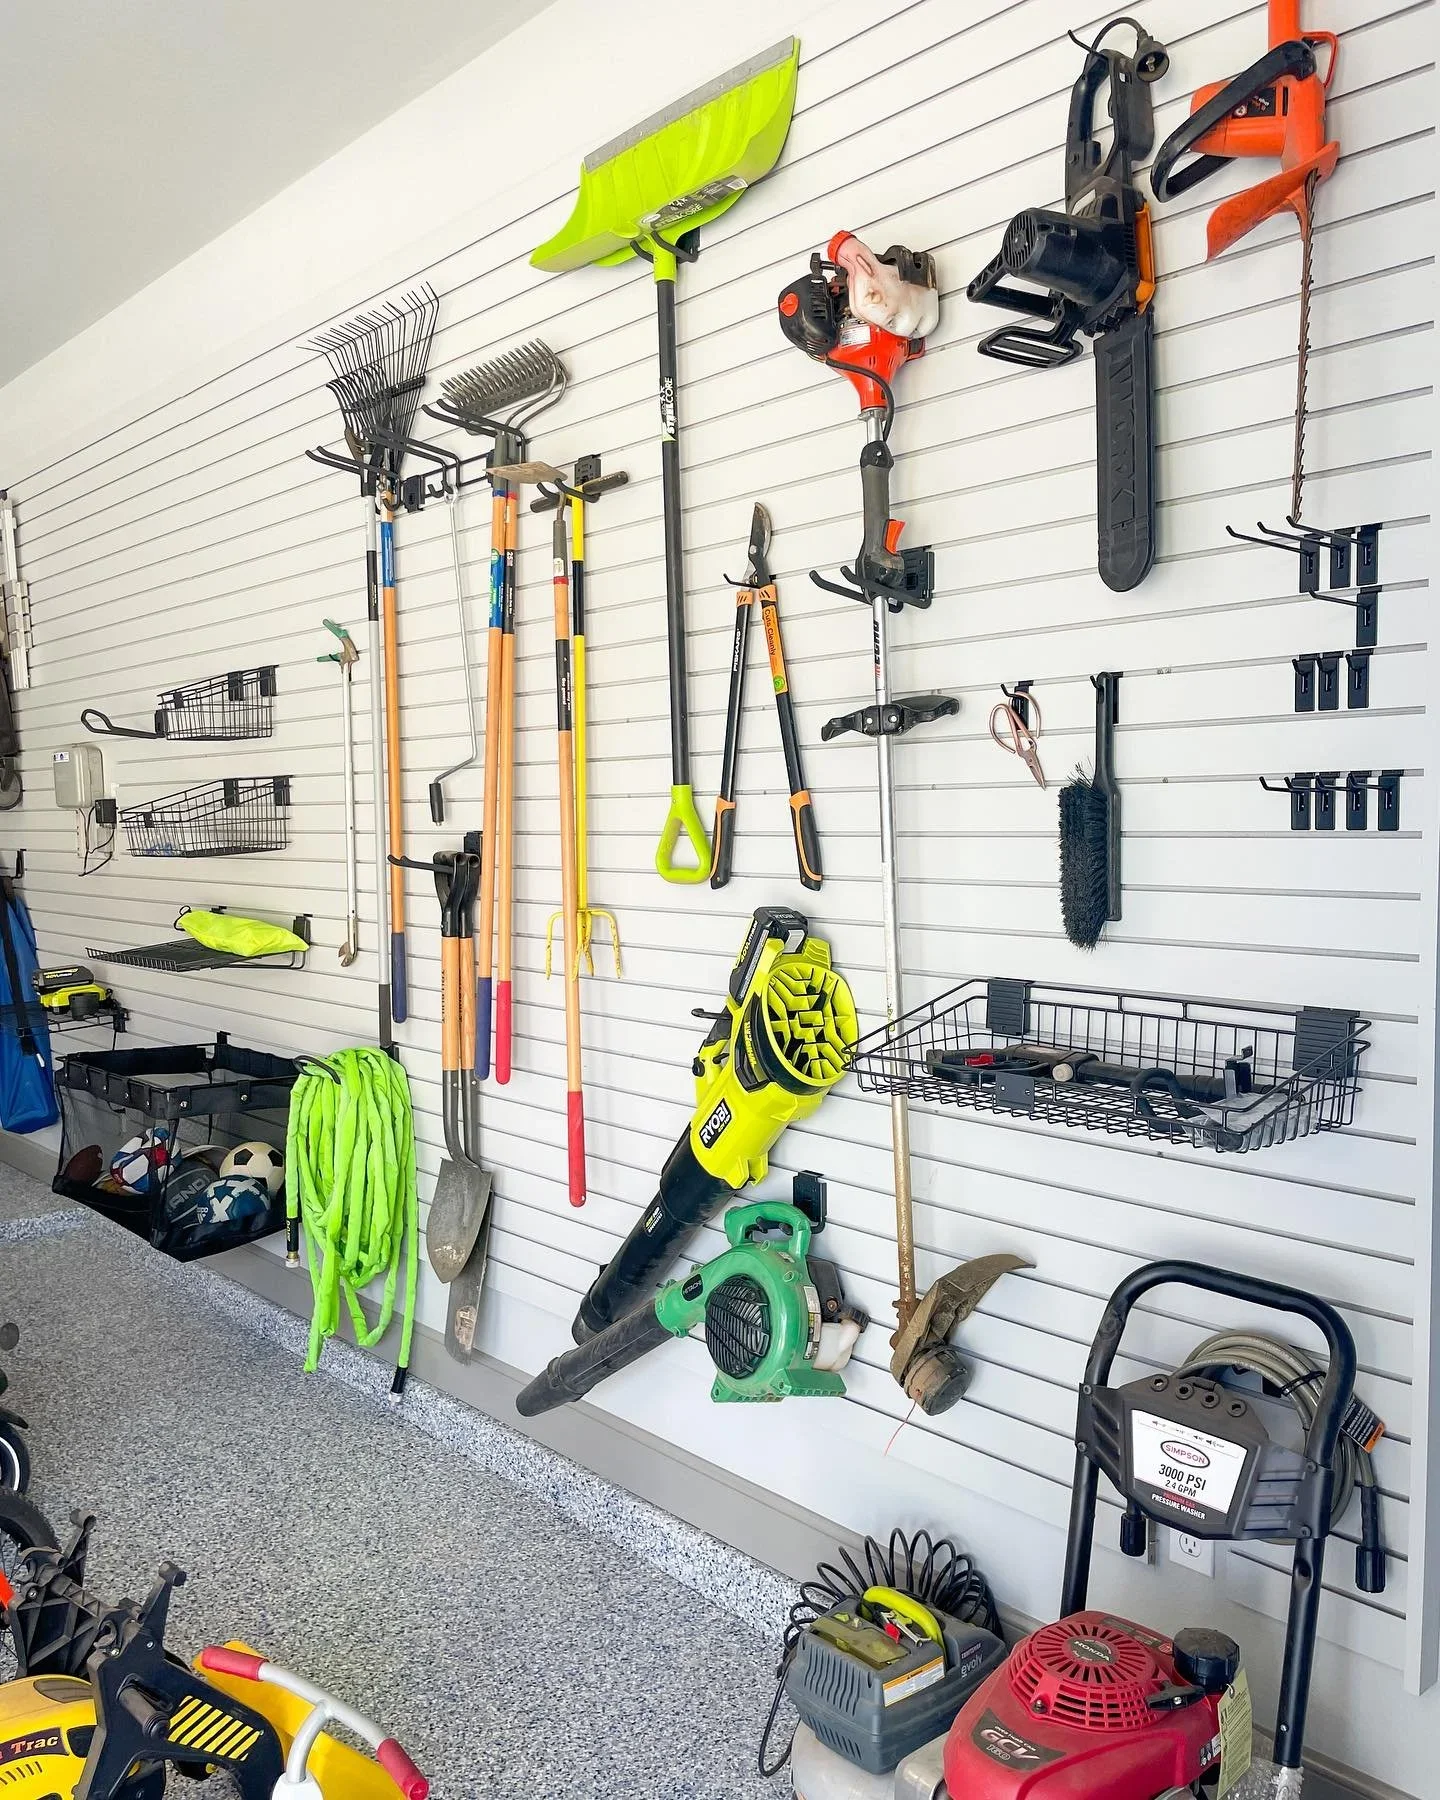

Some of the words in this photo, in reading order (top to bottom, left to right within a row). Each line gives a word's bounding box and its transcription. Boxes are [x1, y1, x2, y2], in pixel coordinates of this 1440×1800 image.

[700, 1101, 729, 1144] RYOBI
[1165, 1444, 1205, 1464] SIMPSON
[1158, 1464, 1184, 1482] 3000
[1186, 1473, 1206, 1491] PSI
[1165, 1479, 1176, 1490] 2.4
[1177, 1484, 1197, 1498] GPM
[1151, 1493, 1181, 1510] PRESSURE
[1180, 1504, 1206, 1520] WASHER
[1074, 1641, 1110, 1662] HONDA
[10, 1736, 59, 1755] Trac
[980, 1729, 1040, 1760] GCV
